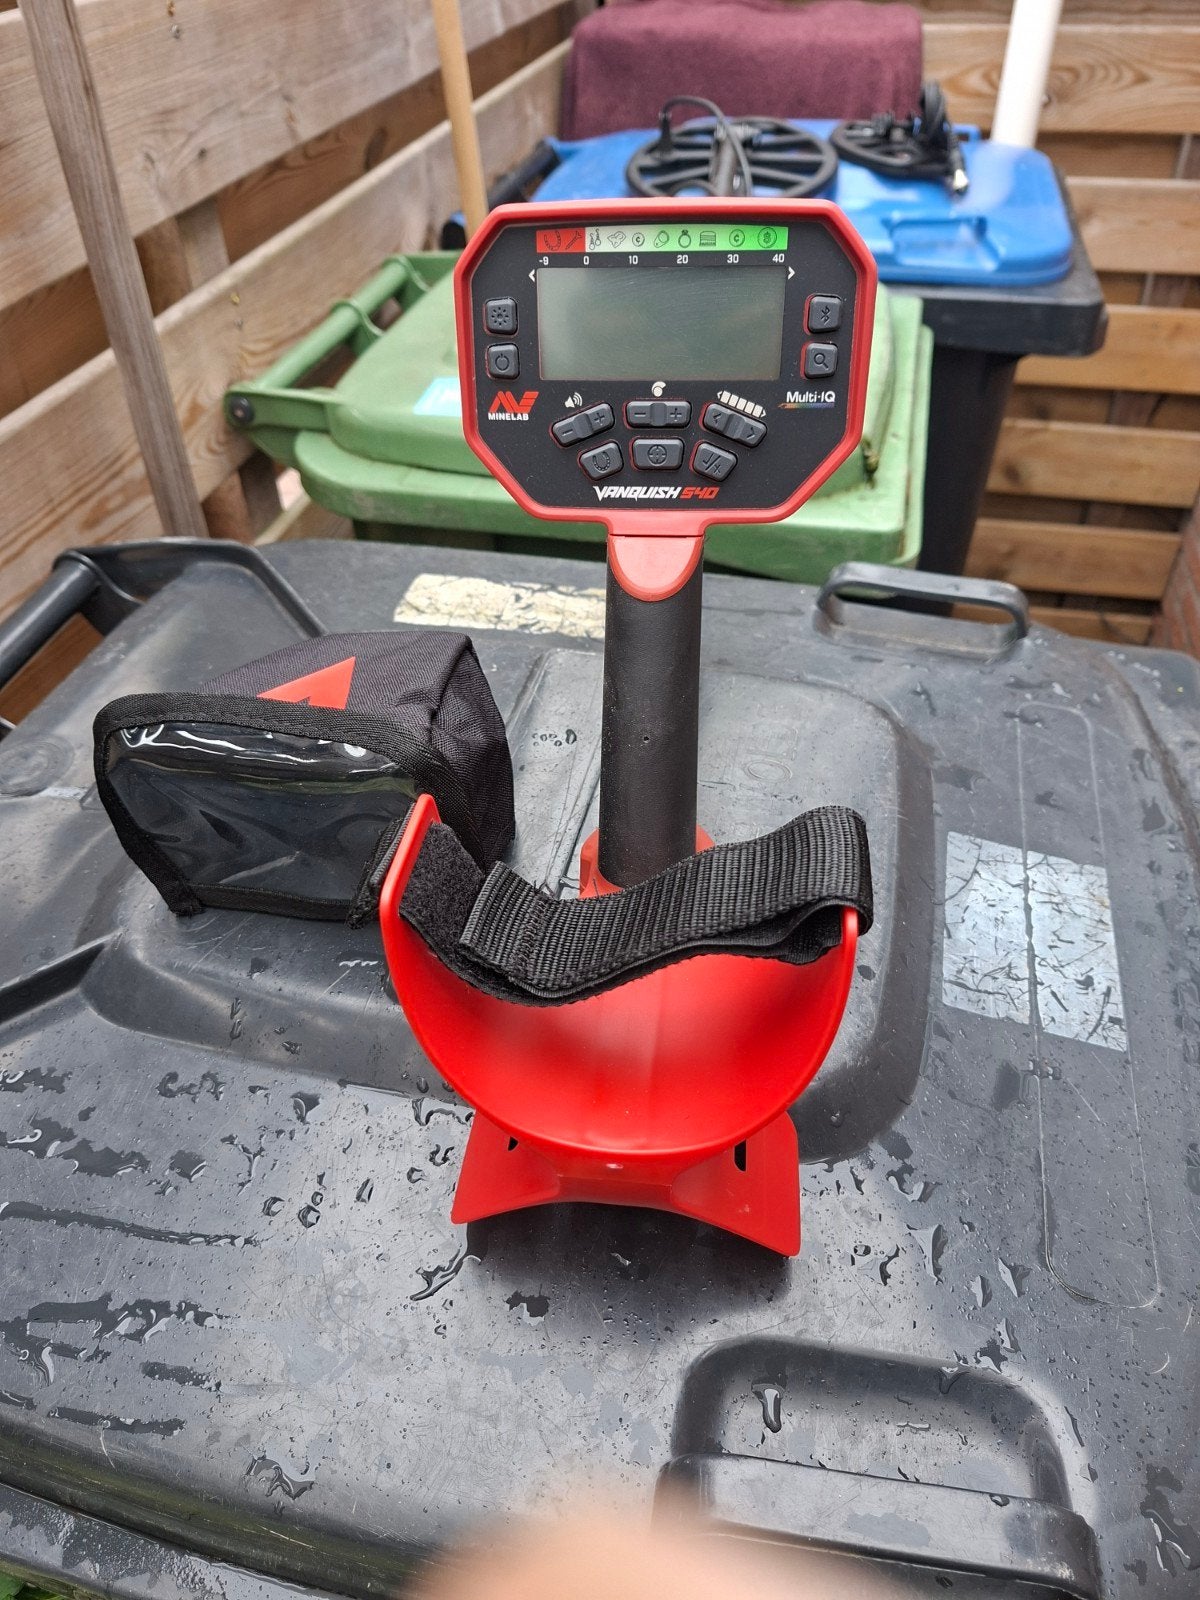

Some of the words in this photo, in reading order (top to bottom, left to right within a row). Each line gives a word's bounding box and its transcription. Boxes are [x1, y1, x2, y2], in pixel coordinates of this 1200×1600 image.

[539, 256, 549, 265] -9
[583, 256, 590, 265] 0
[628, 255, 639, 265] 10
[676, 254, 689, 264] 20
[727, 254, 739, 263] 30
[772, 253, 785, 263] 40
[487, 412, 529, 421] MINELAB
[592, 485, 682, 502] VANQUISH
[680, 486, 720, 499] 540
